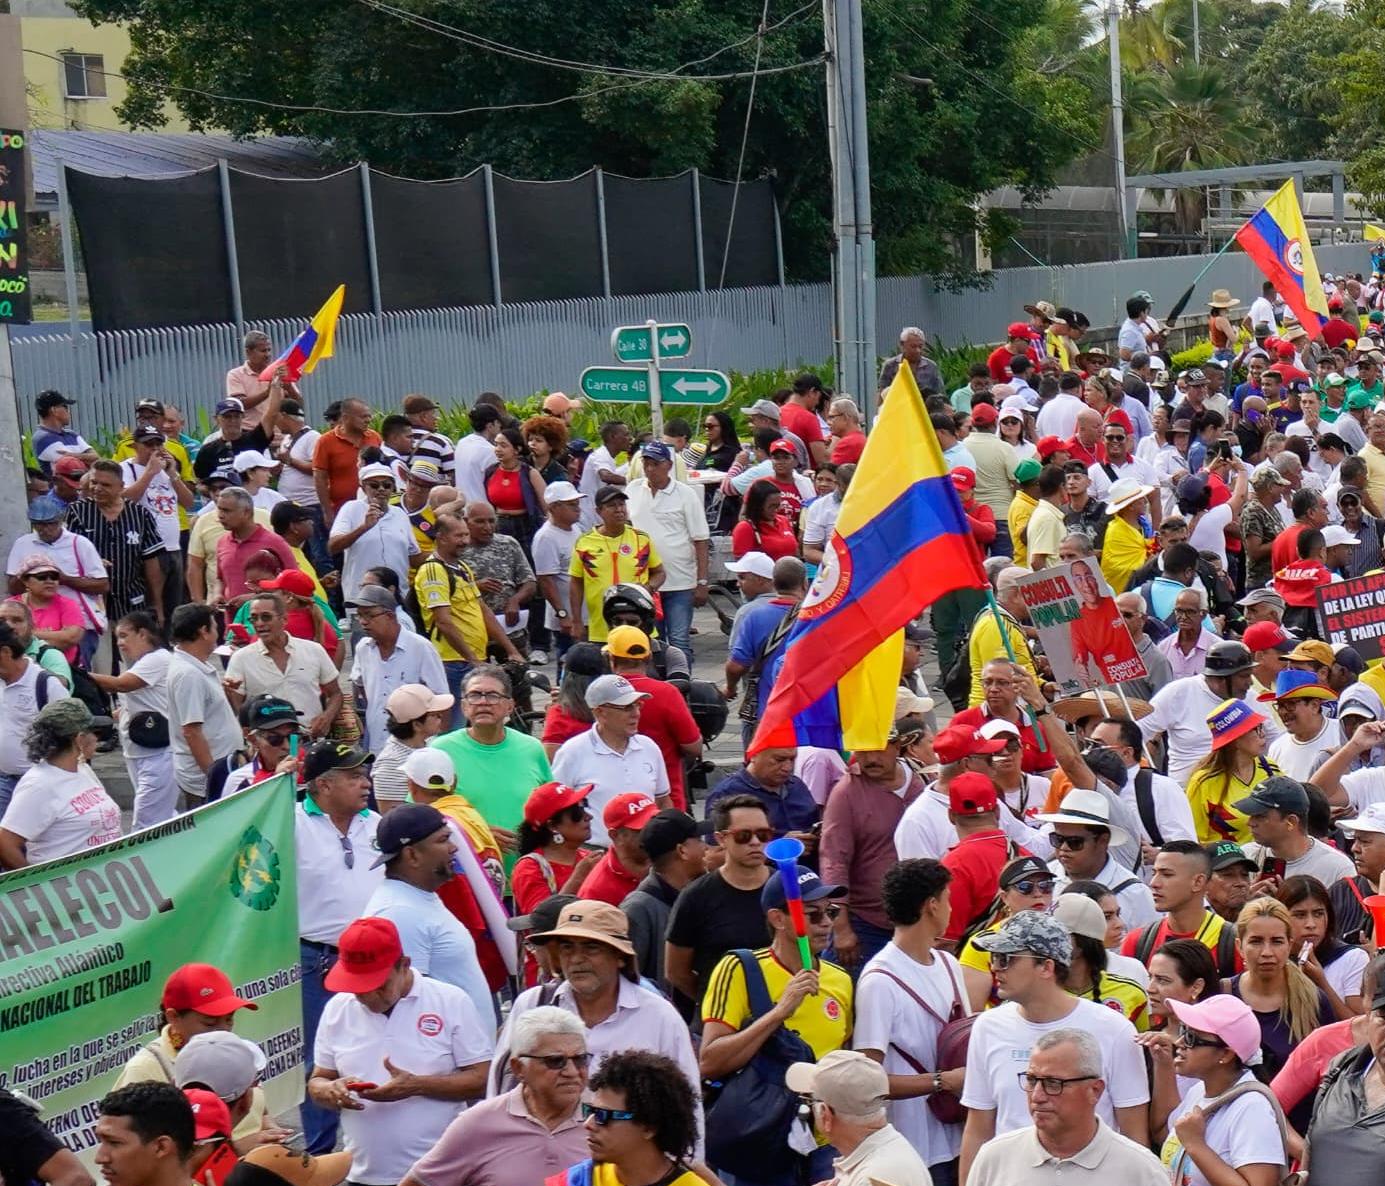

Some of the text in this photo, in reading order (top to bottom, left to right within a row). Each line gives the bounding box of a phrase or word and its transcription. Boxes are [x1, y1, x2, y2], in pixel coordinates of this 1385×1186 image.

[618, 340, 635, 351] Calle
[587, 379, 628, 391] Carrera
[1020, 576, 1074, 605] CONSULTA
[1321, 578, 1363, 600] POR LA
[1324, 598, 1340, 615] DE
[1340, 595, 1355, 612] LA
[1355, 591, 1374, 610] LEY
[1327, 614, 1341, 631] EL
[1331, 631, 1348, 644] DE
[1214, 707, 1244, 731] COLOMBIA
[61, 941, 125, 978] Atlántico
[0, 960, 152, 1033] NACIONAL DEL TRABAJO
[13, 1056, 51, 1082] lucha
[52, 1052, 68, 1072] en
[69, 1044, 81, 1066] la
[82, 1038, 104, 1063] que
[106, 1034, 121, 1052] se
[28, 1067, 84, 1100] intereses
